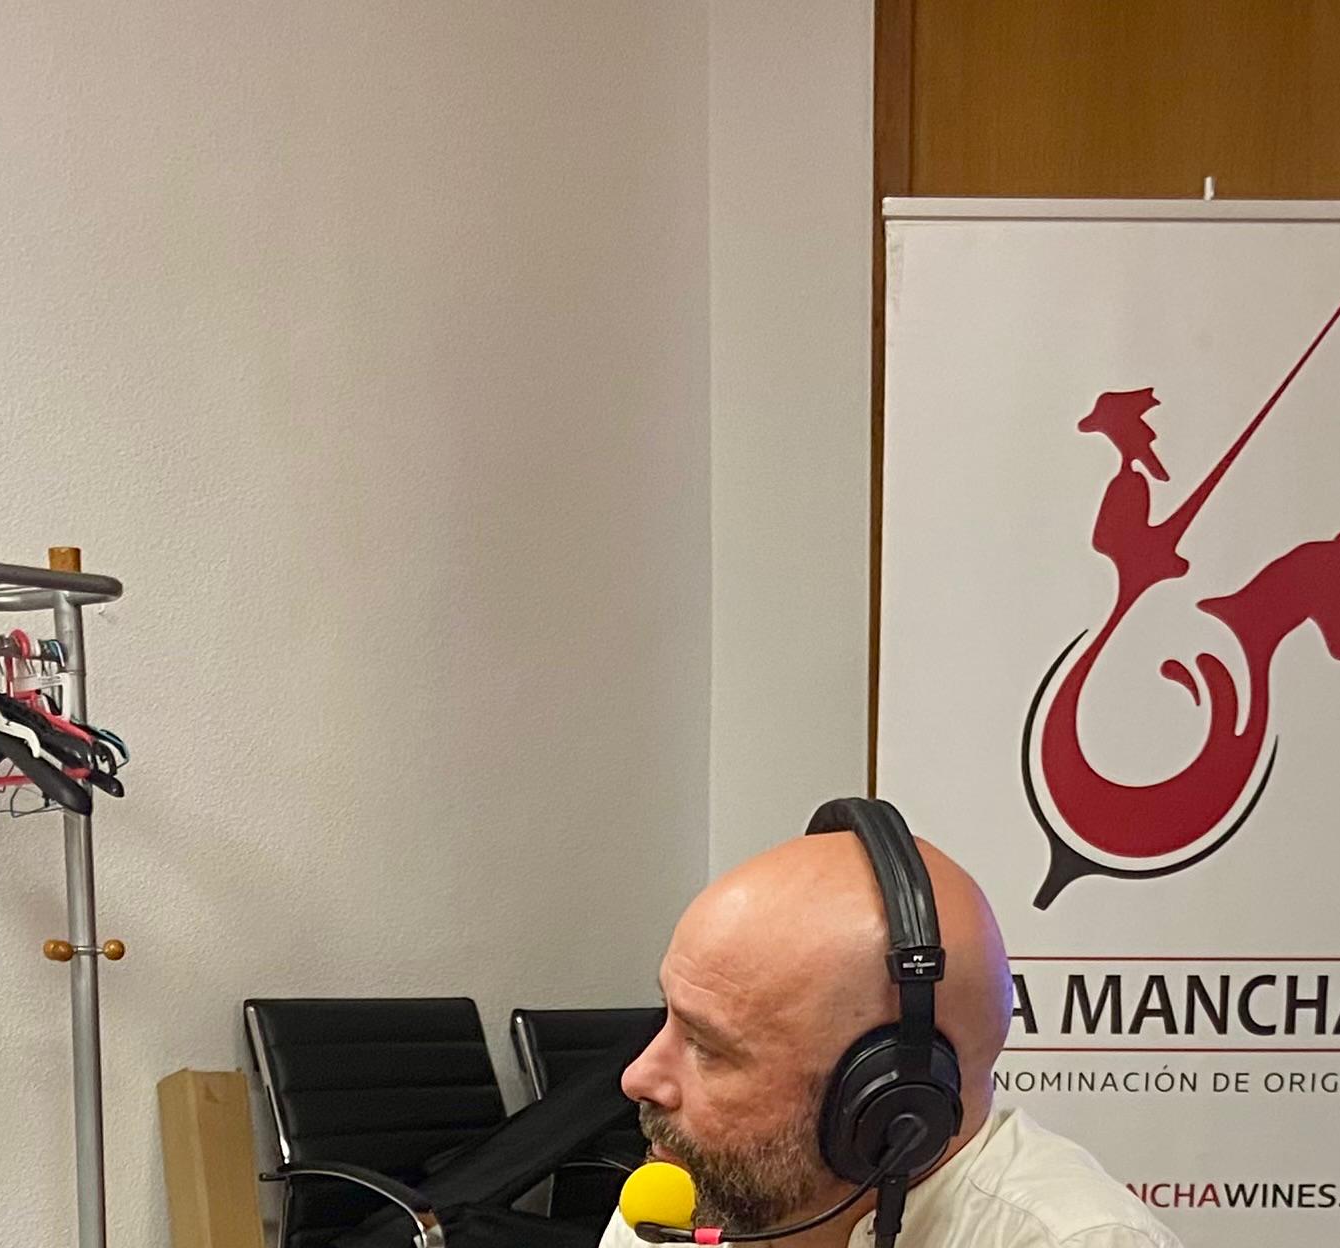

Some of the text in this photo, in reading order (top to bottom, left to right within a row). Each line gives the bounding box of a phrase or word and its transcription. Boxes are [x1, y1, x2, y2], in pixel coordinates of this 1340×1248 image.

[1011, 974, 1039, 1035] A
[993, 1065, 1197, 1093] NOMINACIÓN
[1212, 1072, 1250, 1093] DE
